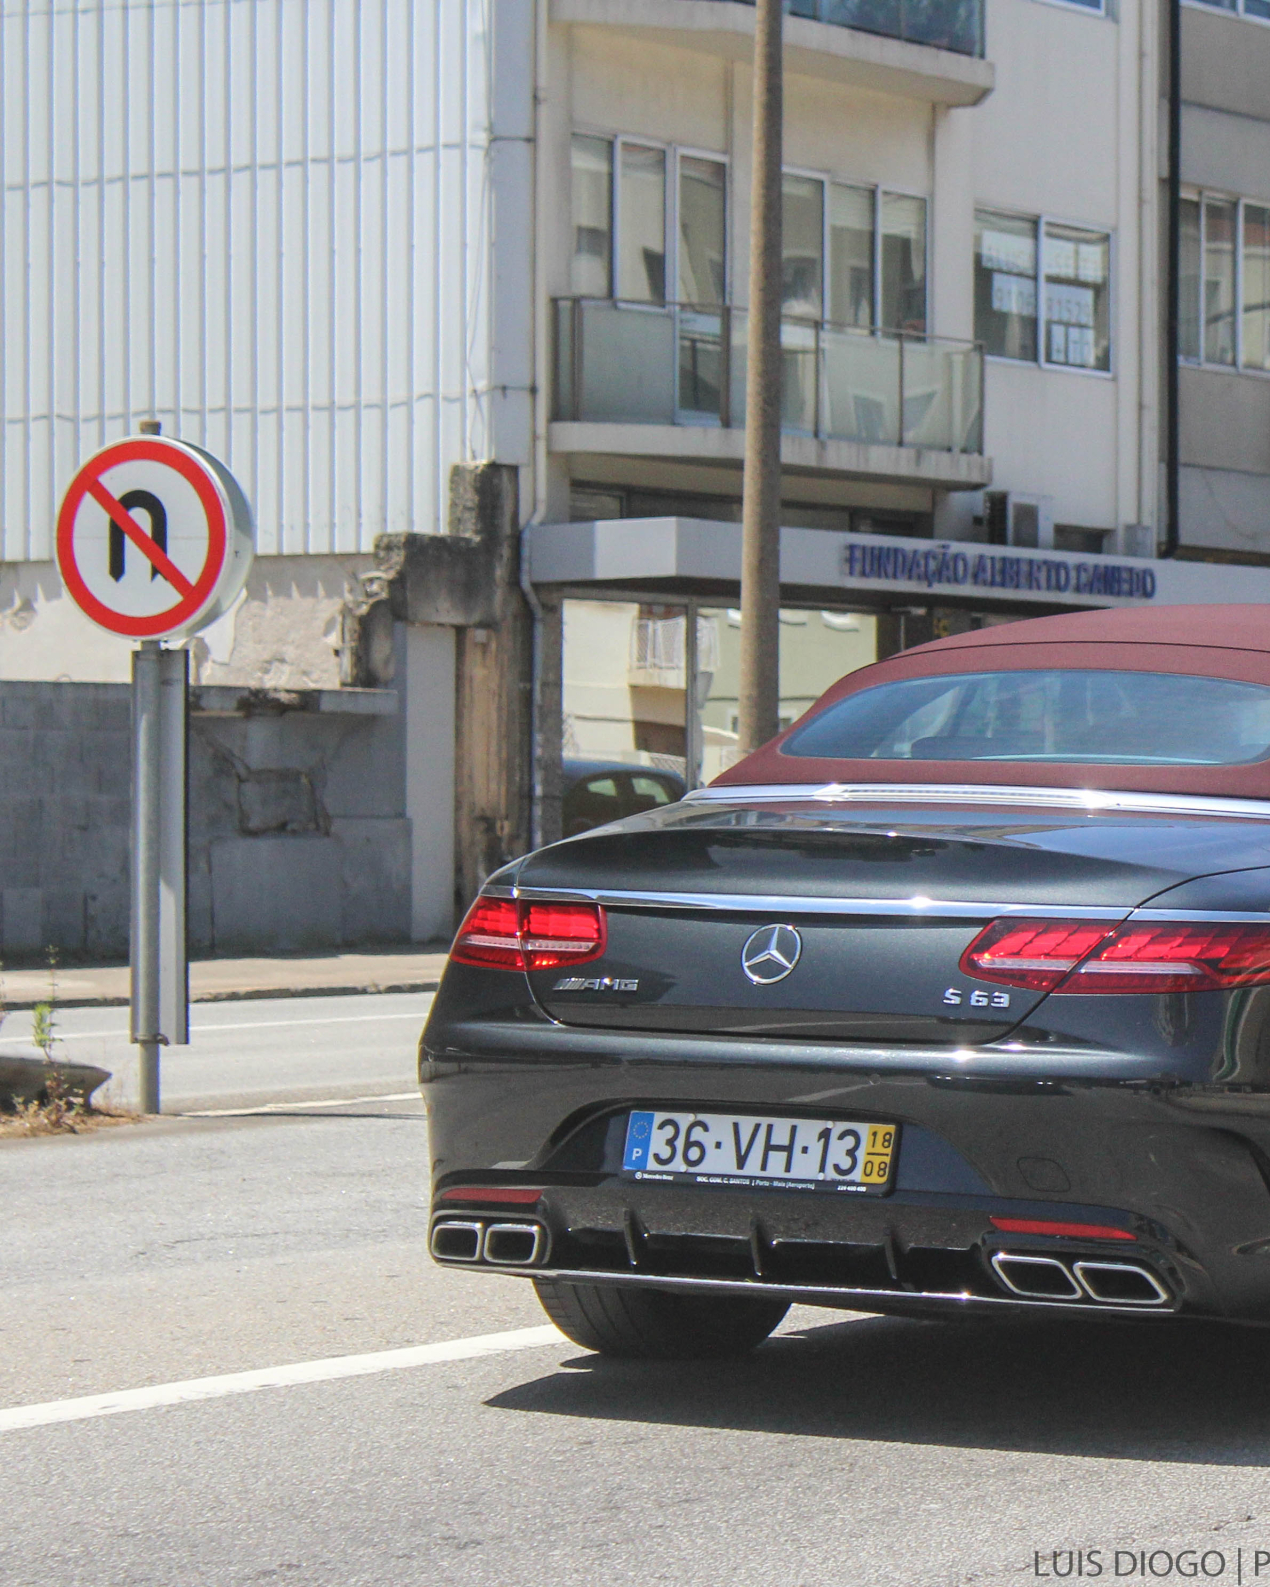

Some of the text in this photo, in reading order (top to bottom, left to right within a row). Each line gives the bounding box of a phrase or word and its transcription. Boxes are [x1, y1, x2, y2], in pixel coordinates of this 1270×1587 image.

[849, 544, 967, 587] FUNDAÇÃO
[973, 554, 1071, 593] ALBERTO
[576, 977, 639, 991] AMG
[943, 988, 1010, 1008] S 63
[871, 1131, 893, 1149] 18
[632, 1148, 642, 1160] P
[864, 1160, 888, 1178] 08
